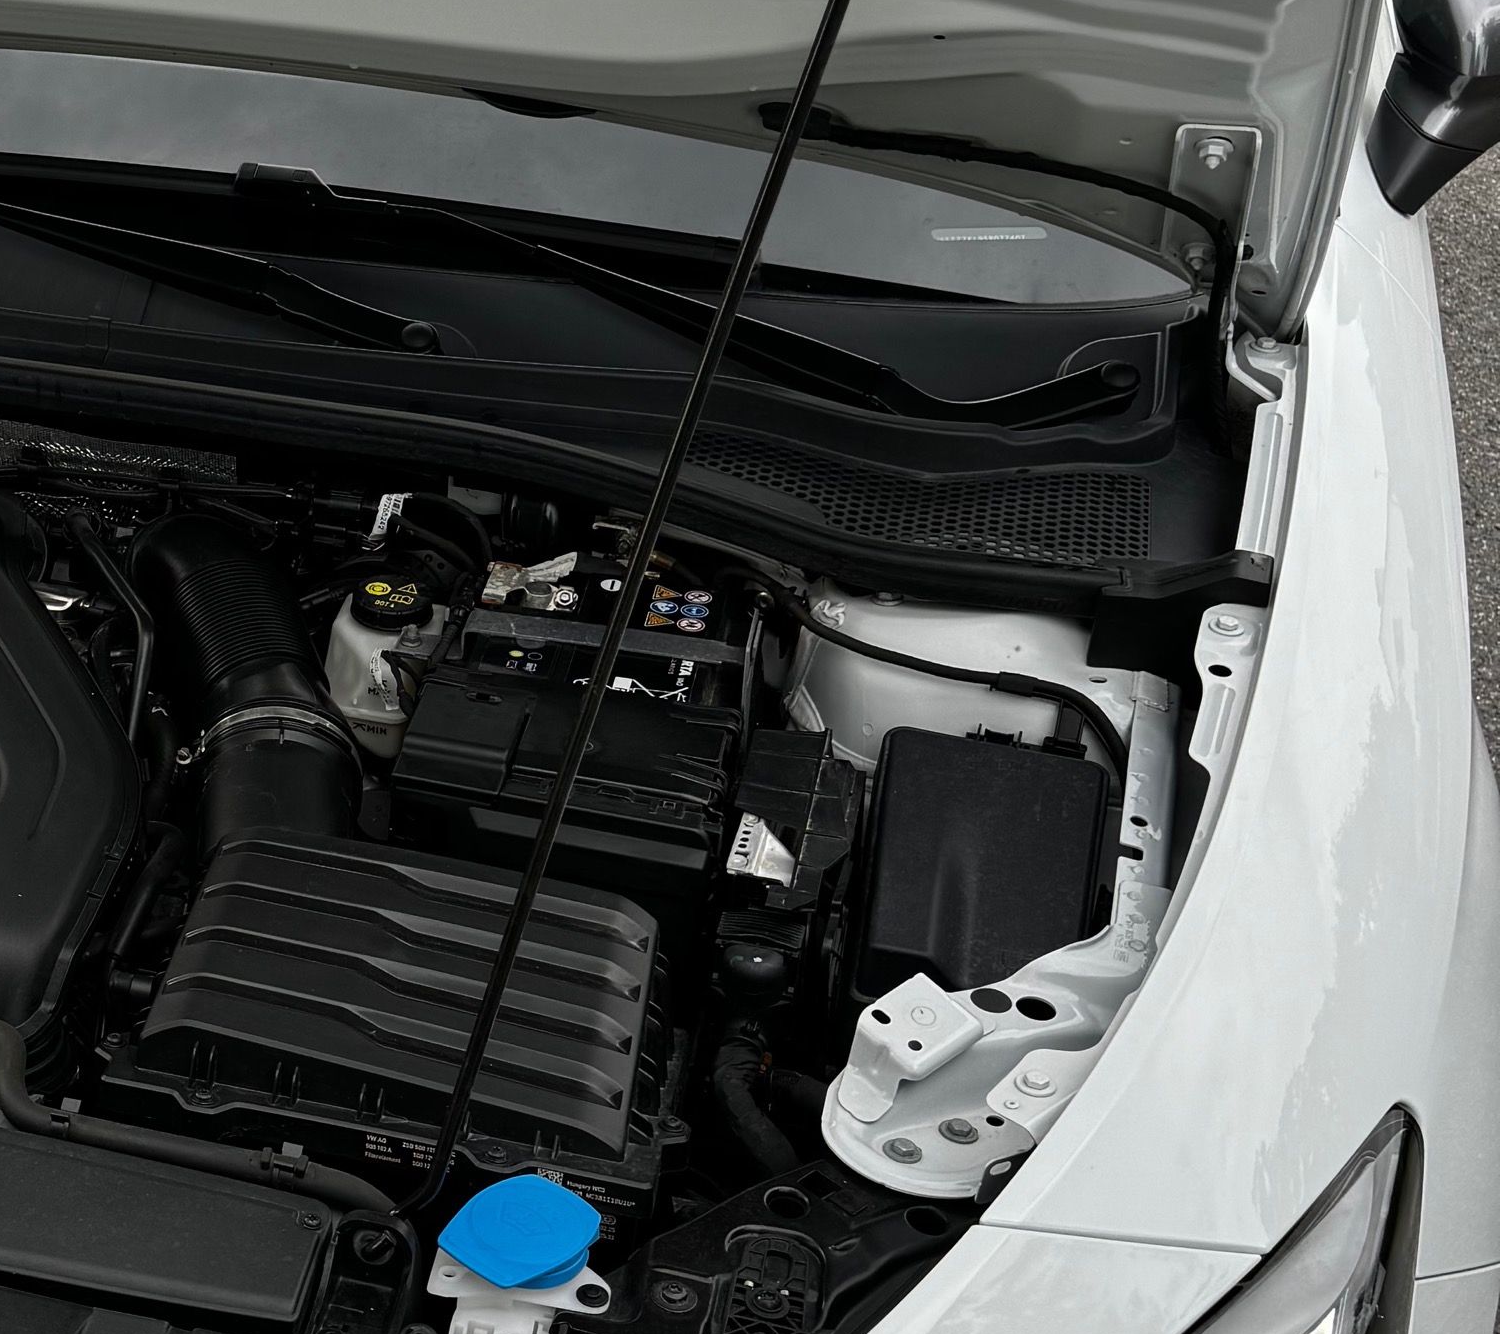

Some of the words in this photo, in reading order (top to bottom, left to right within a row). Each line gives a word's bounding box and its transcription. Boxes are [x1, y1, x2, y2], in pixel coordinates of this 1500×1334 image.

[374, 599, 389, 607] DOT
[366, 723, 387, 736] MIN
[366, 1134, 377, 1142] VW
[377, 1136, 387, 1144] AG
